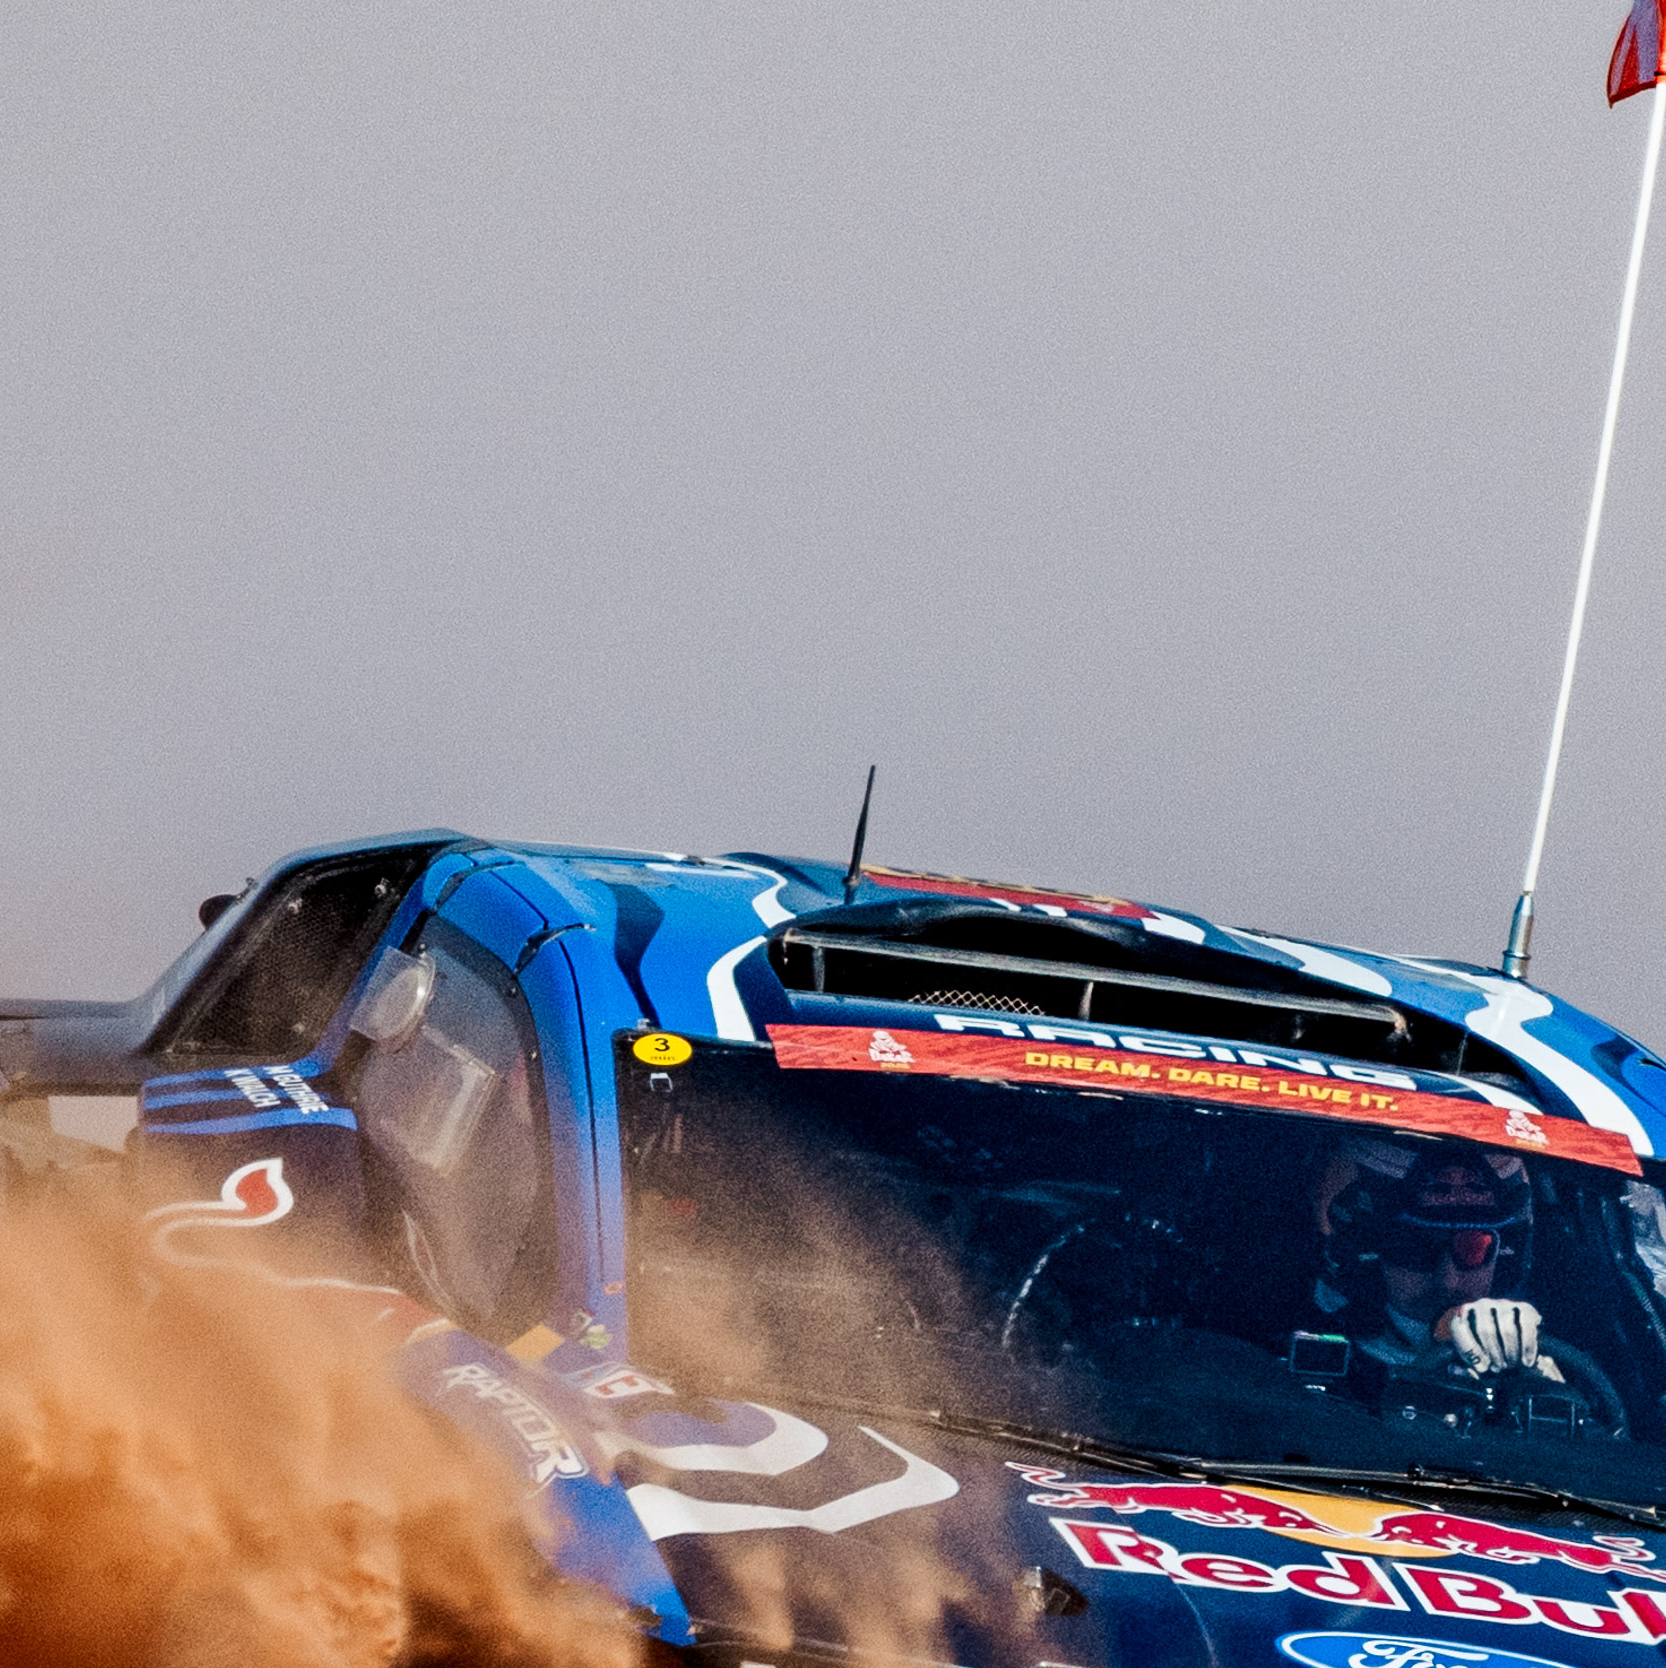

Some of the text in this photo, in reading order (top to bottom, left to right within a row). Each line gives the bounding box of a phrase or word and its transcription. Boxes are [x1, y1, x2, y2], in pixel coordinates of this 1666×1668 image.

[654, 1038, 670, 1052] 3
[933, 1012, 1418, 1091] RACING
[1025, 1051, 1400, 1112] DREAM. DARE. LIVE IT.
[443, 1362, 587, 1484] RAPTOR
[1049, 1516, 1411, 1611] Red
